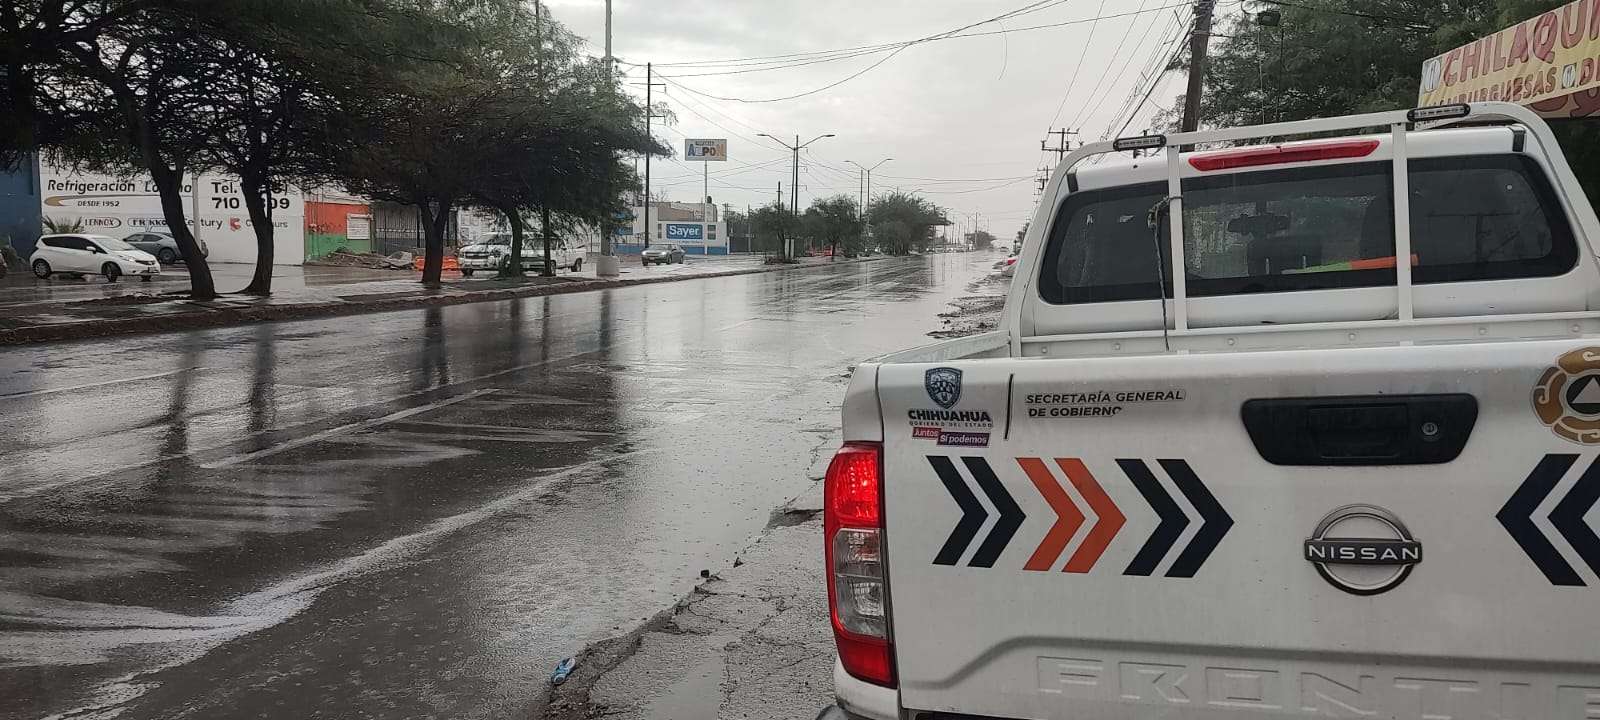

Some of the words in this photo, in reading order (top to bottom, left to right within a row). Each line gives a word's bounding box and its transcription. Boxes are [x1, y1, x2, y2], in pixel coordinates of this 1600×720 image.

[47, 179, 135, 195] Refrigeración
[144, 180, 192, 192] Loo
[211, 182, 238, 194] Tel.
[211, 197, 240, 209] 710
[184, 216, 223, 230] etury
[669, 225, 700, 236] Sayer
[1025, 391, 1111, 404] SECRETARÍA
[1115, 390, 1184, 402] GENERAL
[908, 409, 991, 422] CHIHUAHUA
[1028, 408, 1047, 417] DE
[914, 429, 939, 437] Juntos
[949, 435, 988, 444] podemos
[1308, 544, 1419, 560] NISSAN
